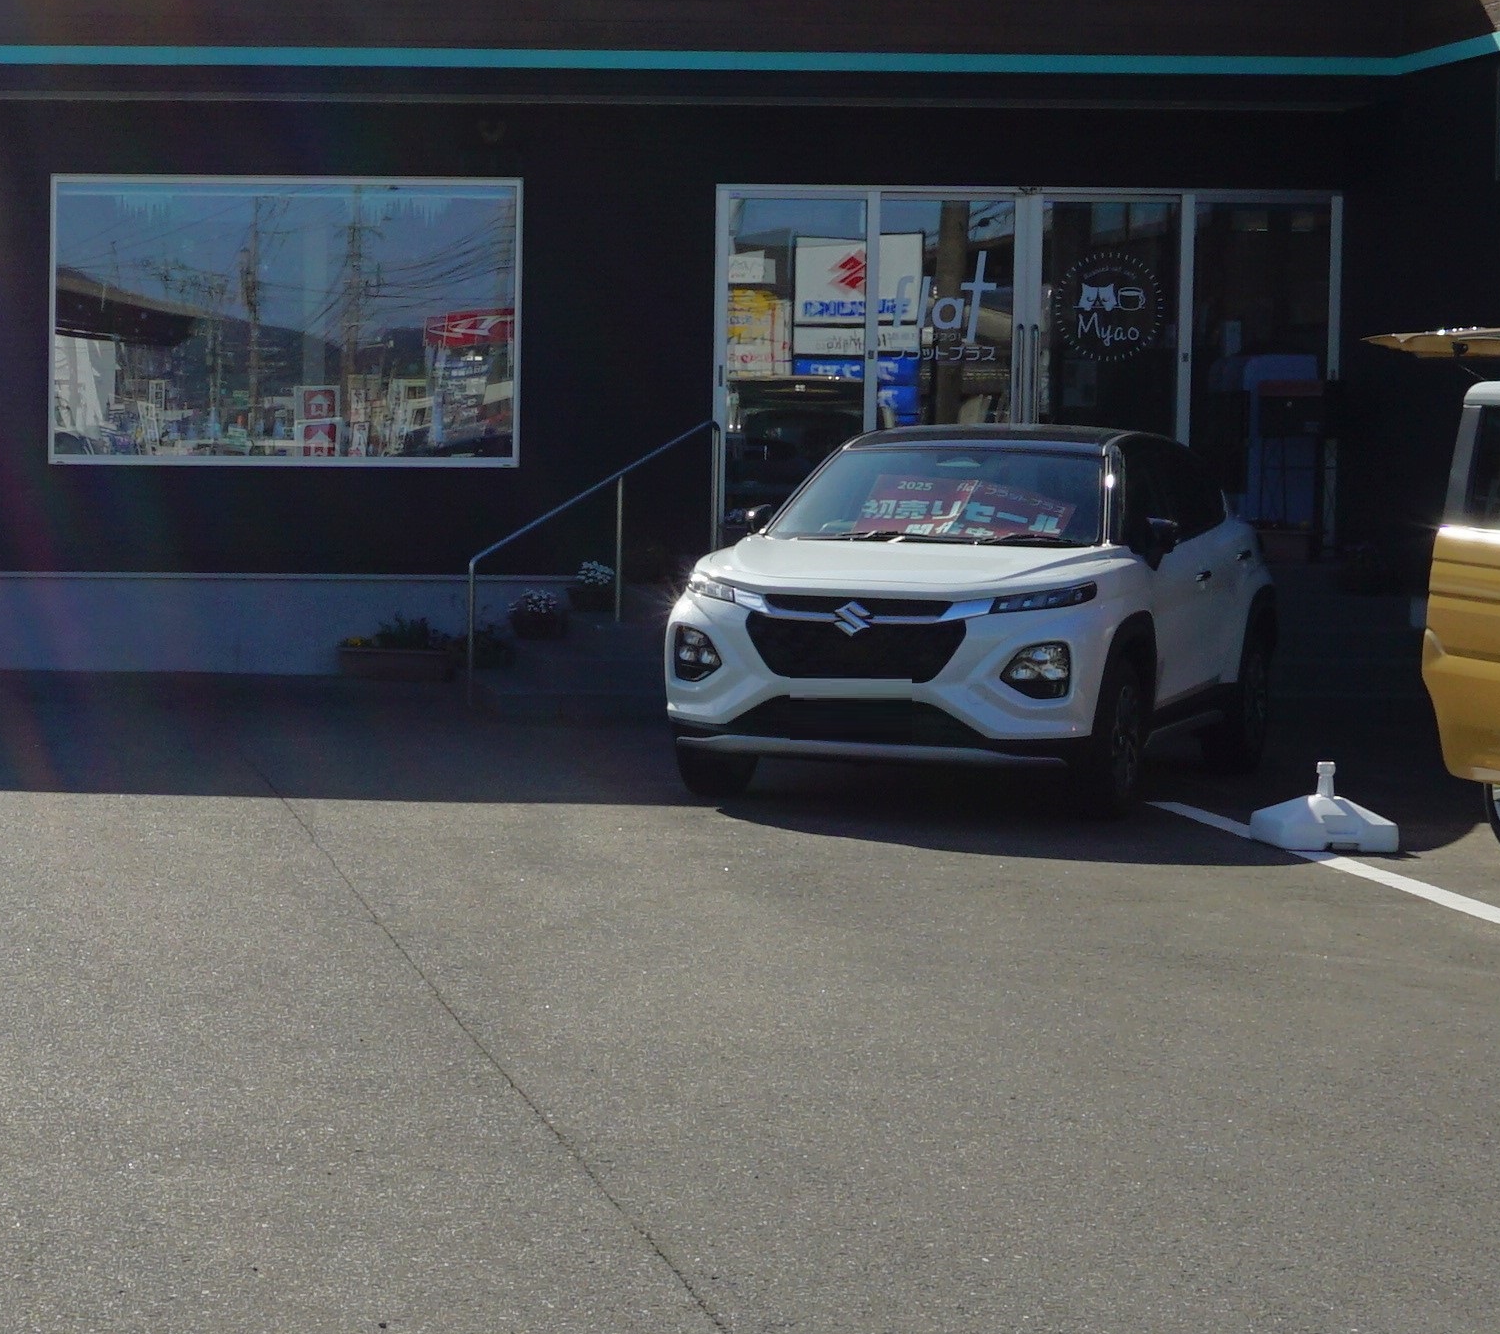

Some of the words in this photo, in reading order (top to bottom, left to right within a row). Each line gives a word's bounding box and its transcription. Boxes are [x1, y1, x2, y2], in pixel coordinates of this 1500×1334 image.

[892, 250, 998, 344] flat
[1077, 311, 1140, 347] Myao
[897, 480, 934, 492] 2025
[861, 499, 1062, 534] 初売りセール
